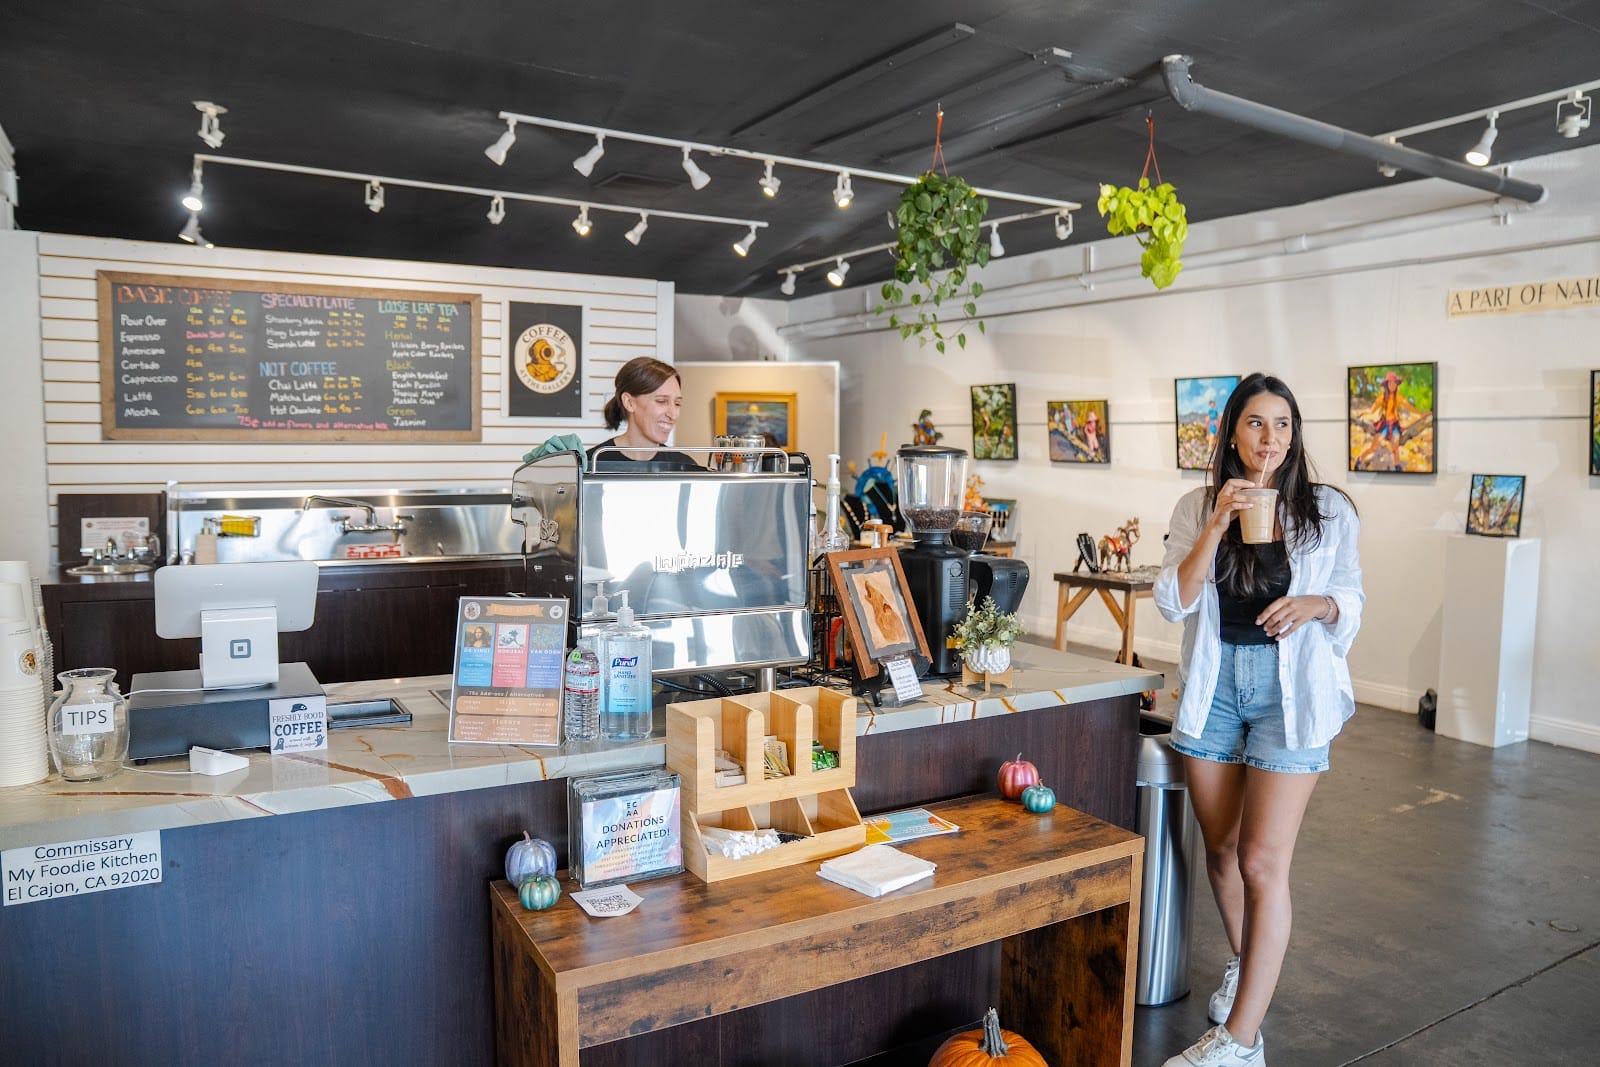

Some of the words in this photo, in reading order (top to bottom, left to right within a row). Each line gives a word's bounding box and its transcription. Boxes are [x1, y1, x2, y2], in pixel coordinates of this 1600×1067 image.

[117, 286, 173, 304] BASIC
[178, 288, 232, 307] COFFEE
[323, 297, 356, 310] LATTE
[1450, 292, 1462, 310] A
[1470, 287, 1512, 309] PART
[1520, 283, 1546, 305] OF
[378, 301, 409, 313] LOOSE
[412, 303, 436, 314] LEAF
[437, 304, 459, 316] TEA
[121, 314, 144, 326] Pour
[145, 315, 167, 326] Over
[120, 331, 160, 343] Espresso
[522, 326, 568, 344] COFFEE
[121, 347, 165, 356] Americano
[121, 360, 160, 370] Cortado
[260, 362, 287, 377] NOT
[290, 361, 337, 376] COFFEE
[122, 375, 178, 386] Cappuccino
[268, 379, 292, 390] Chai
[542, 370, 572, 391] GALLERY
[124, 407, 160, 417] Mocha
[270, 405, 287, 415] Hot
[393, 417, 426, 427] Jasmine
[67, 709, 107, 727] TIPS
[274, 721, 322, 737] COFFEE
[602, 815, 664, 835] DONATIONS
[596, 828, 670, 849] APPRECIATED!
[34, 838, 133, 860] Commissary
[8, 868, 35, 883] My
[41, 859, 95, 877] Foodie
[101, 852, 158, 869] Kitchen
[8, 886, 22, 901] El
[28, 882, 80, 899] Cajon,
[85, 876, 107, 889] CA
[111, 867, 160, 885] 92020
